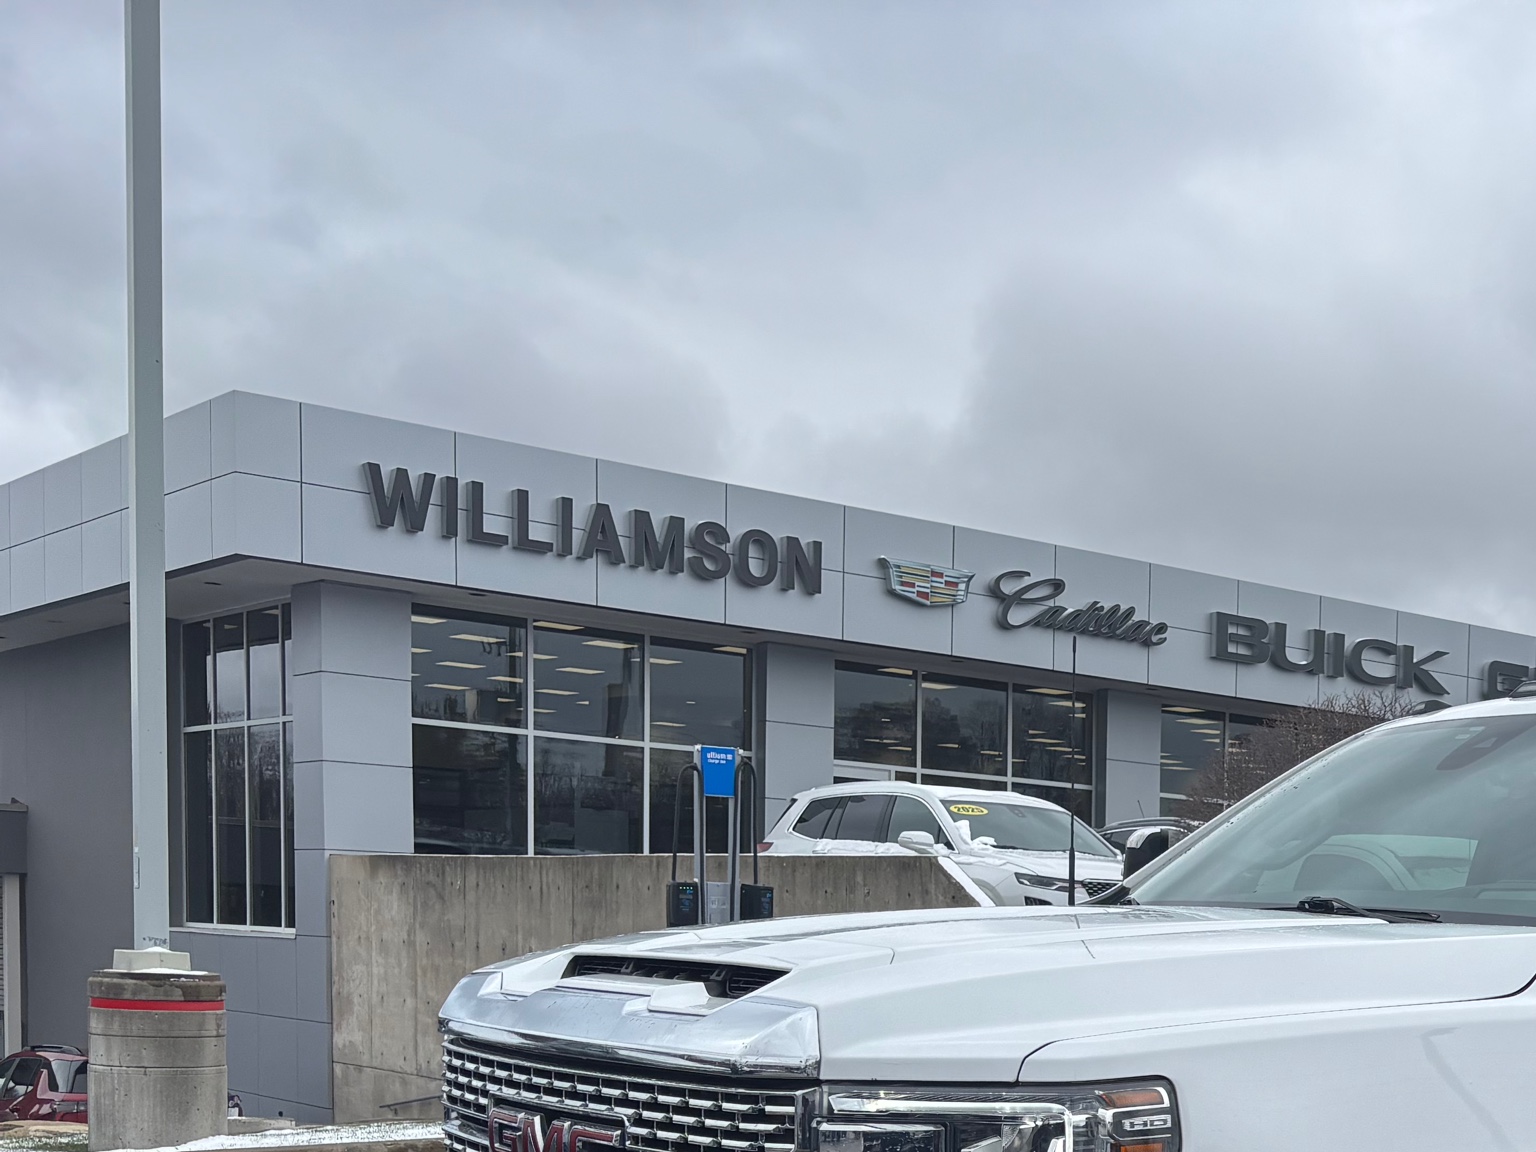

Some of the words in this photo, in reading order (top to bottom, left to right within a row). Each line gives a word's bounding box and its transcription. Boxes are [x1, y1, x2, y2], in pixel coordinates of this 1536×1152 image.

[362, 462, 822, 594] WILLIAMSON
[990, 570, 1169, 646] Cadillac
[1209, 611, 1450, 695] BUICK
[1122, 1115, 1171, 1130] HD
